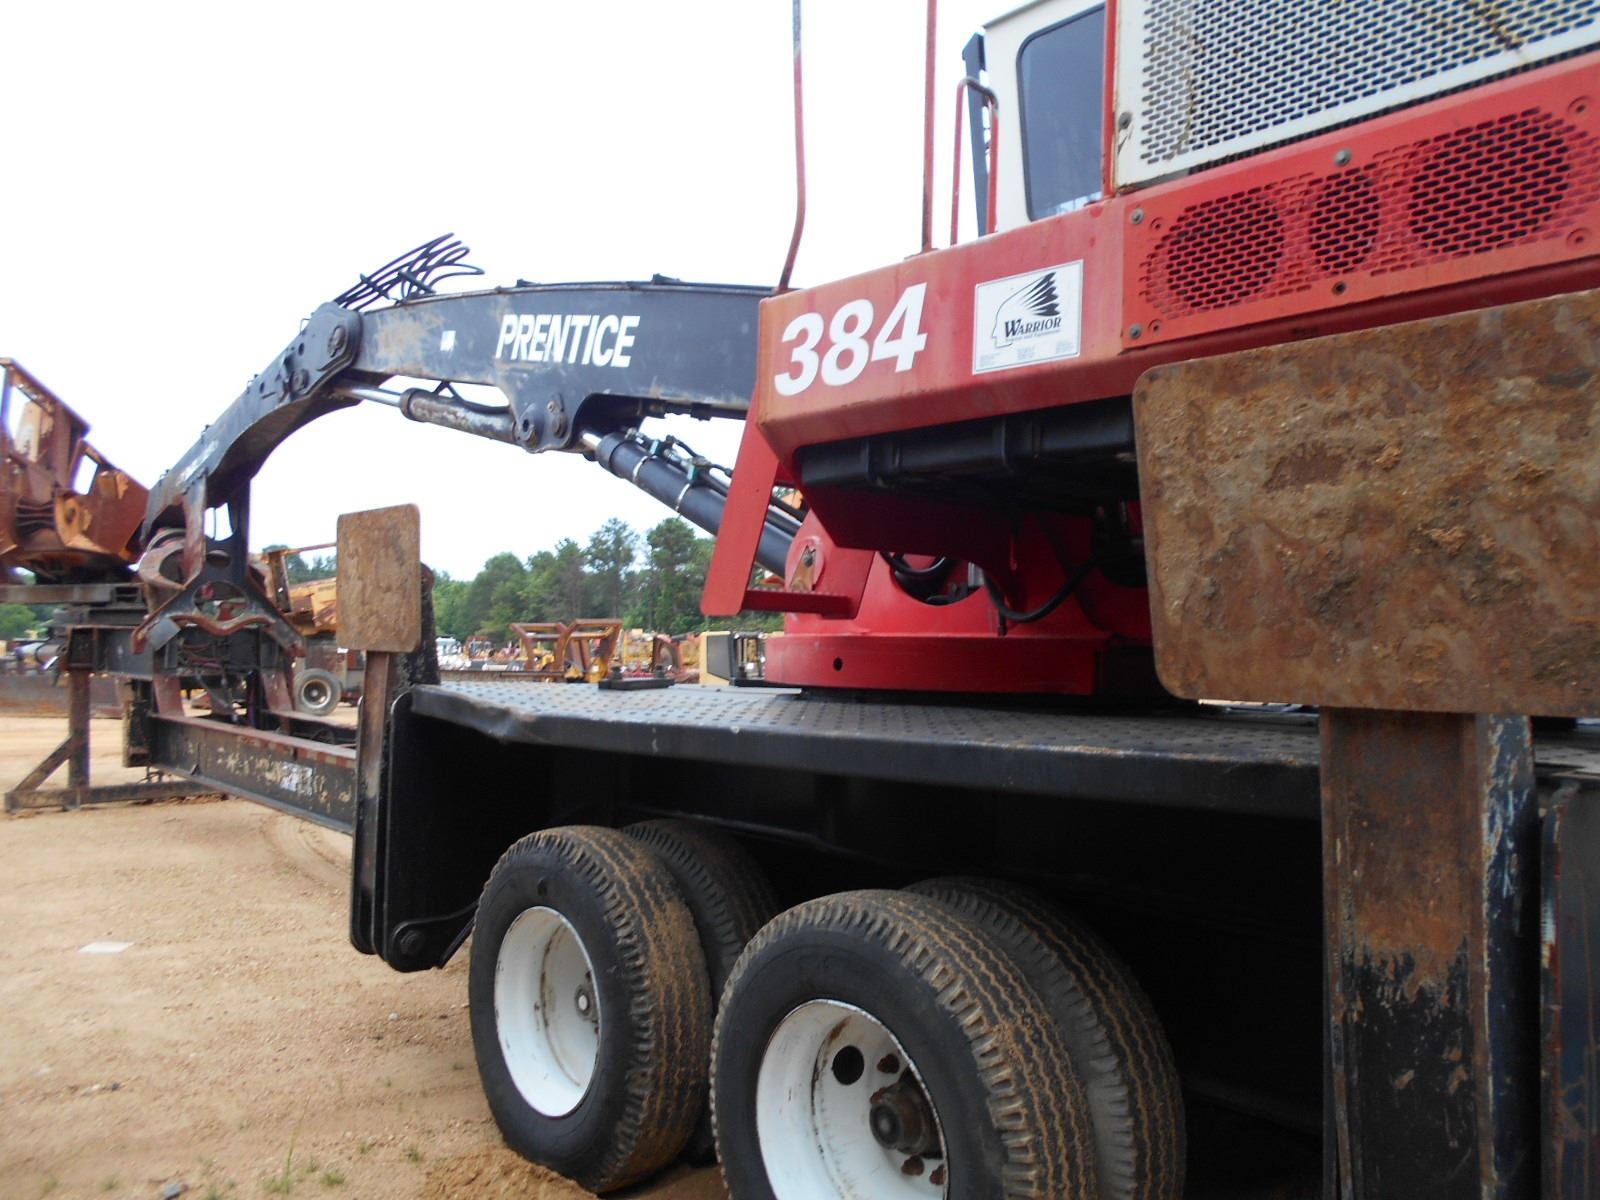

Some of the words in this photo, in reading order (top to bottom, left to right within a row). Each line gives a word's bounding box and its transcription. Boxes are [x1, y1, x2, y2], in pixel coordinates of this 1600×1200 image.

[495, 314, 640, 368] PRENTICE
[774, 282, 928, 396] 384
[1004, 317, 1062, 338] WARRIOR
